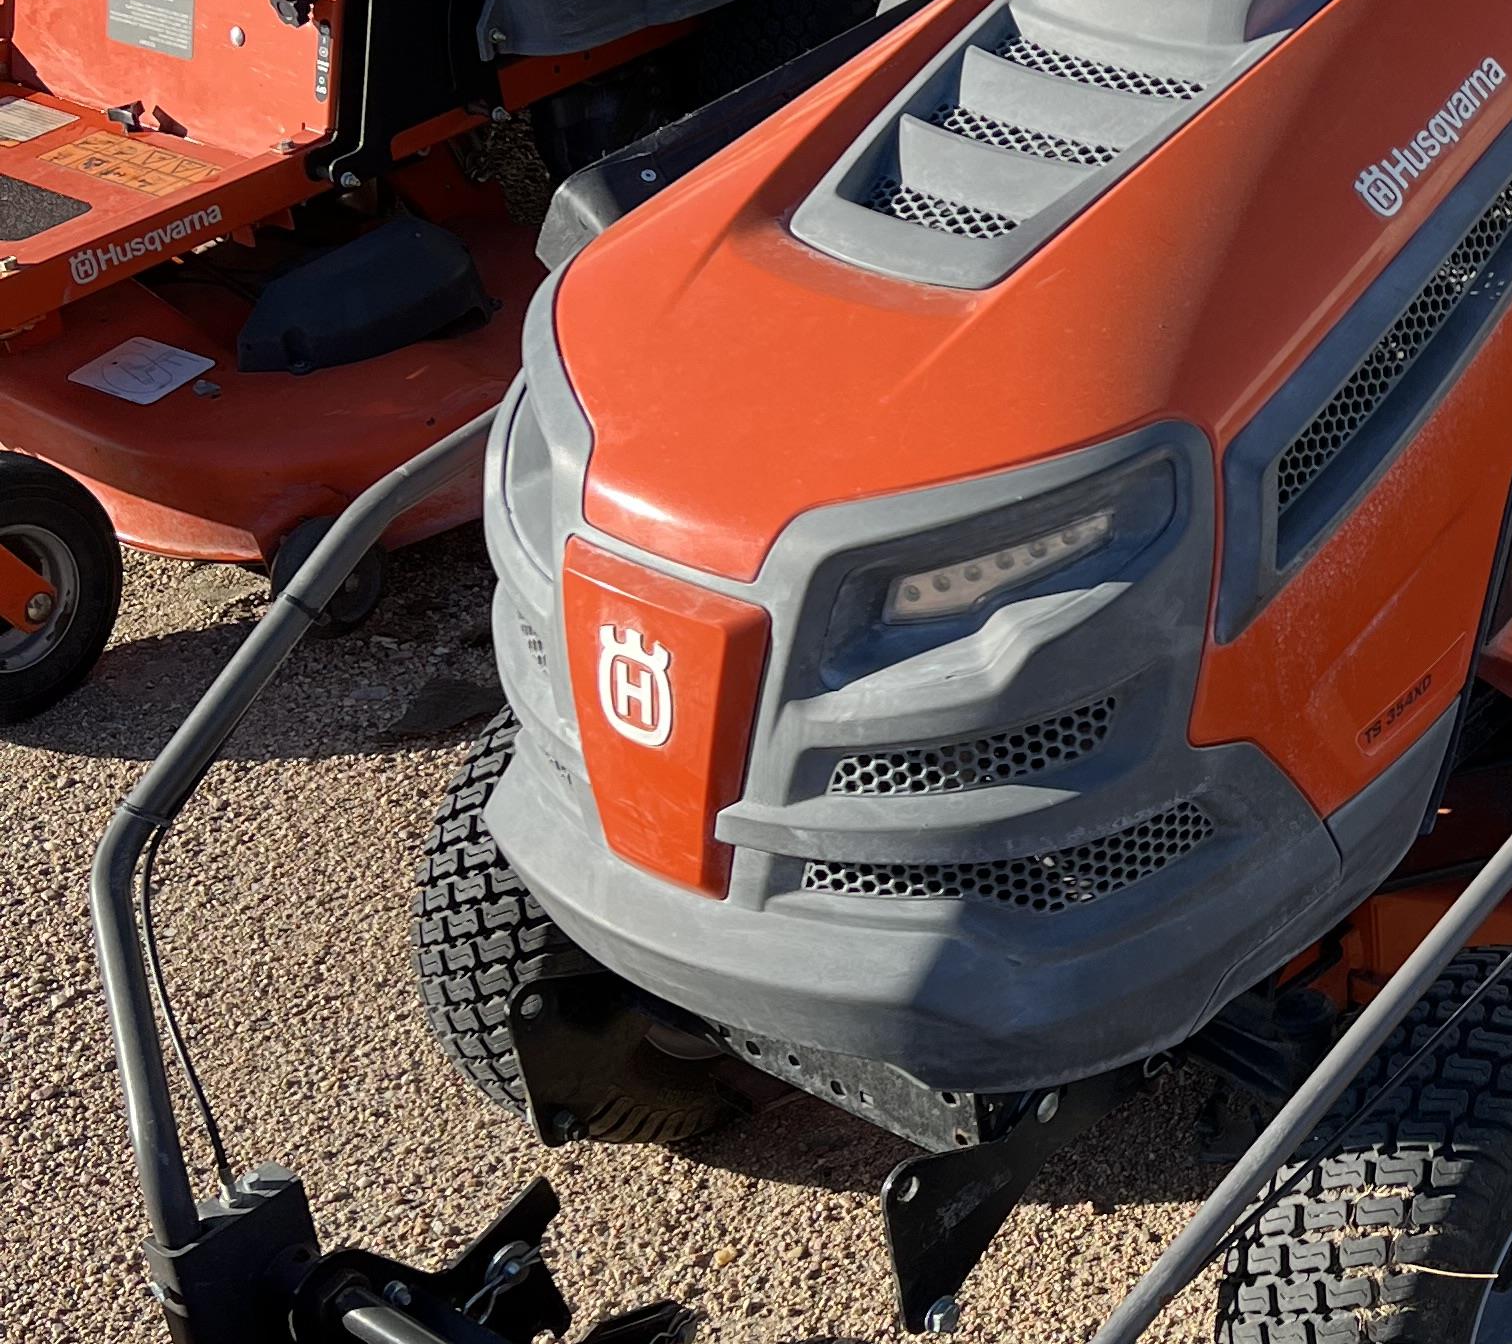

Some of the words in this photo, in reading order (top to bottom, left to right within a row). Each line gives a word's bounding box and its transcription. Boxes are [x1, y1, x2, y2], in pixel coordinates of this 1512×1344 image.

[1381, 57, 1506, 189] Husqvarna
[96, 205, 223, 271] Husqvarna
[1364, 719, 1382, 743] TS
